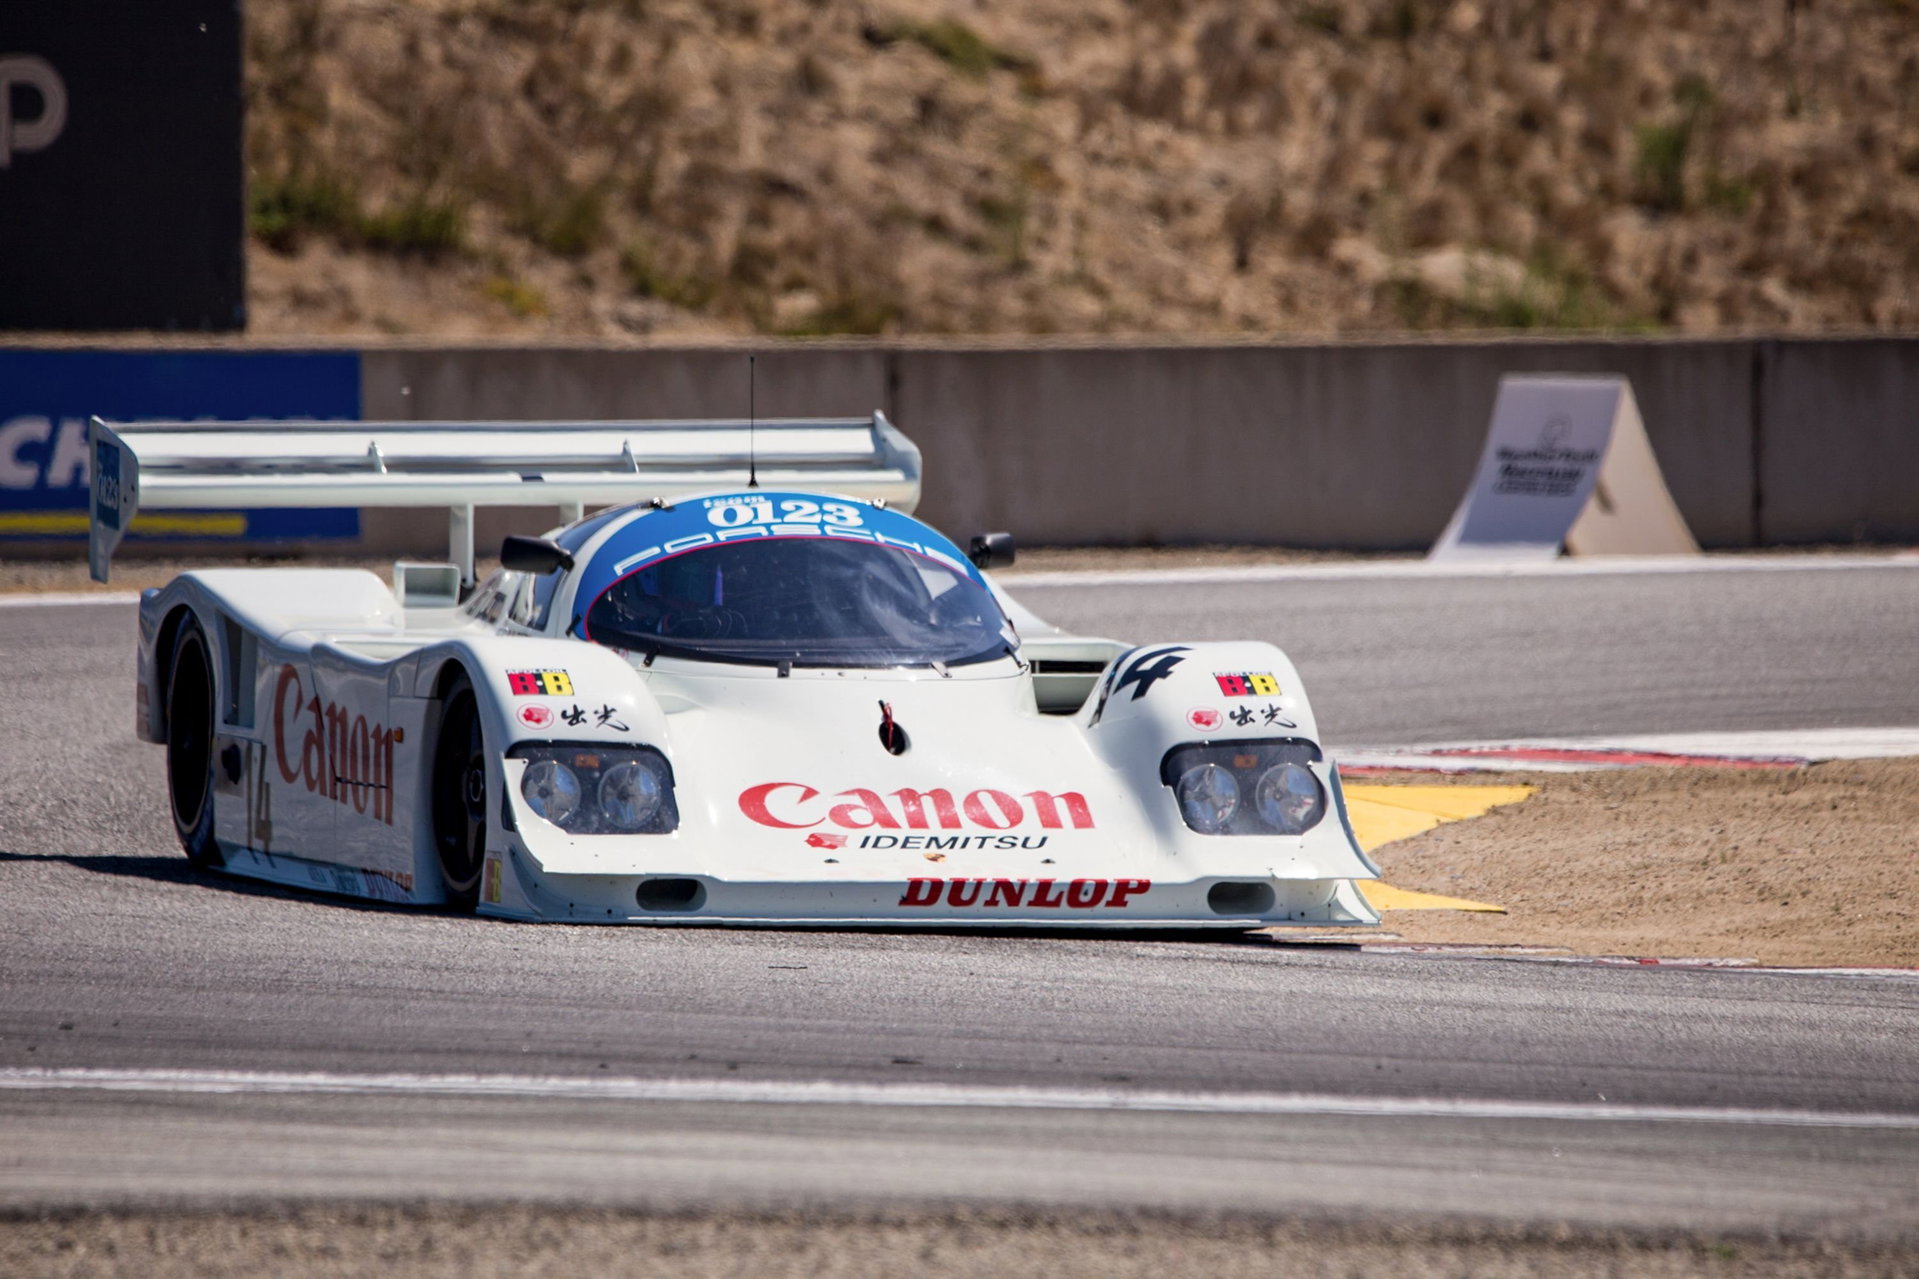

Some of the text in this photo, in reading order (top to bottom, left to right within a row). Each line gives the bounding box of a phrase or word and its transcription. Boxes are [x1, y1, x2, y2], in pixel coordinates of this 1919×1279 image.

[707, 500, 864, 527] 0123
[274, 663, 394, 827] Canon
[738, 782, 1095, 829] Canon
[859, 835, 1049, 850] IDEMITSU
[898, 877, 1151, 908] DUNLOP
